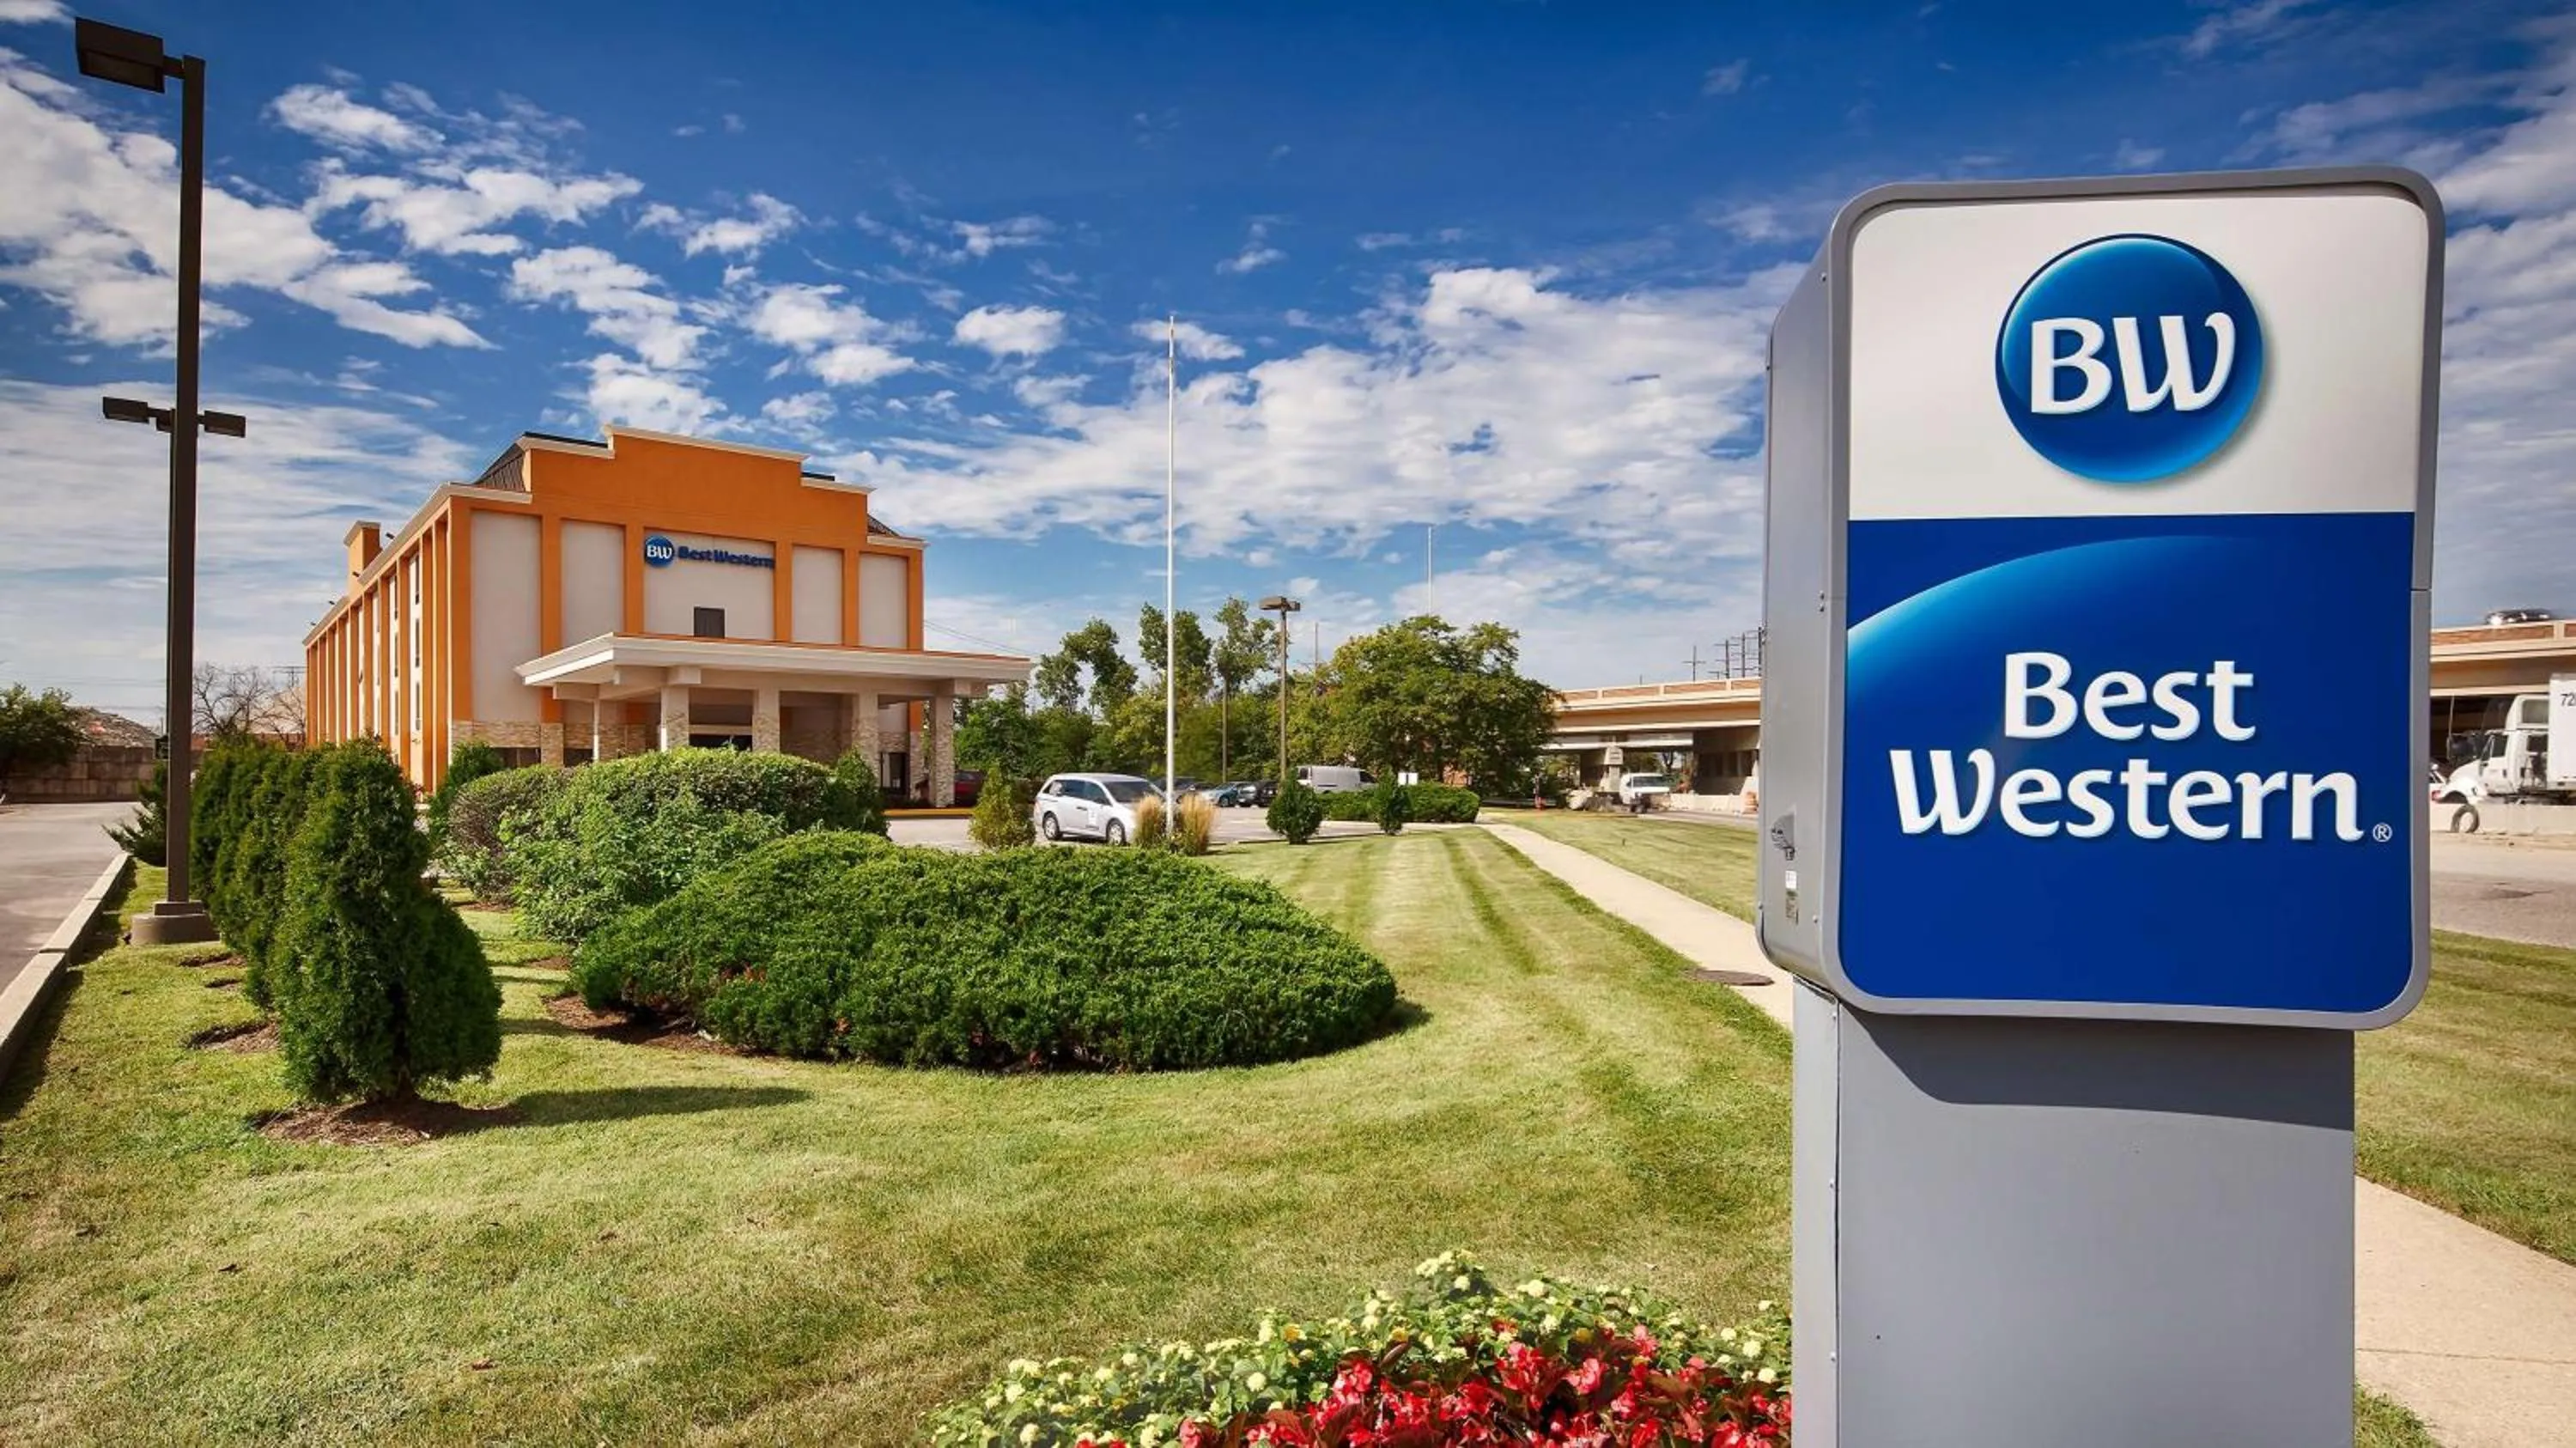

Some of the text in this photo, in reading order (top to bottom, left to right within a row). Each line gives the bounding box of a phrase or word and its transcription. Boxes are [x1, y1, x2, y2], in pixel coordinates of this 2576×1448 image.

[2030, 311, 2236, 414] BW
[647, 545, 672, 559] BW
[678, 545, 775, 569] Best Western
[2003, 651, 2257, 741] Best
[2561, 692, 2576, 707] 72
[1889, 747, 2365, 842] Western
